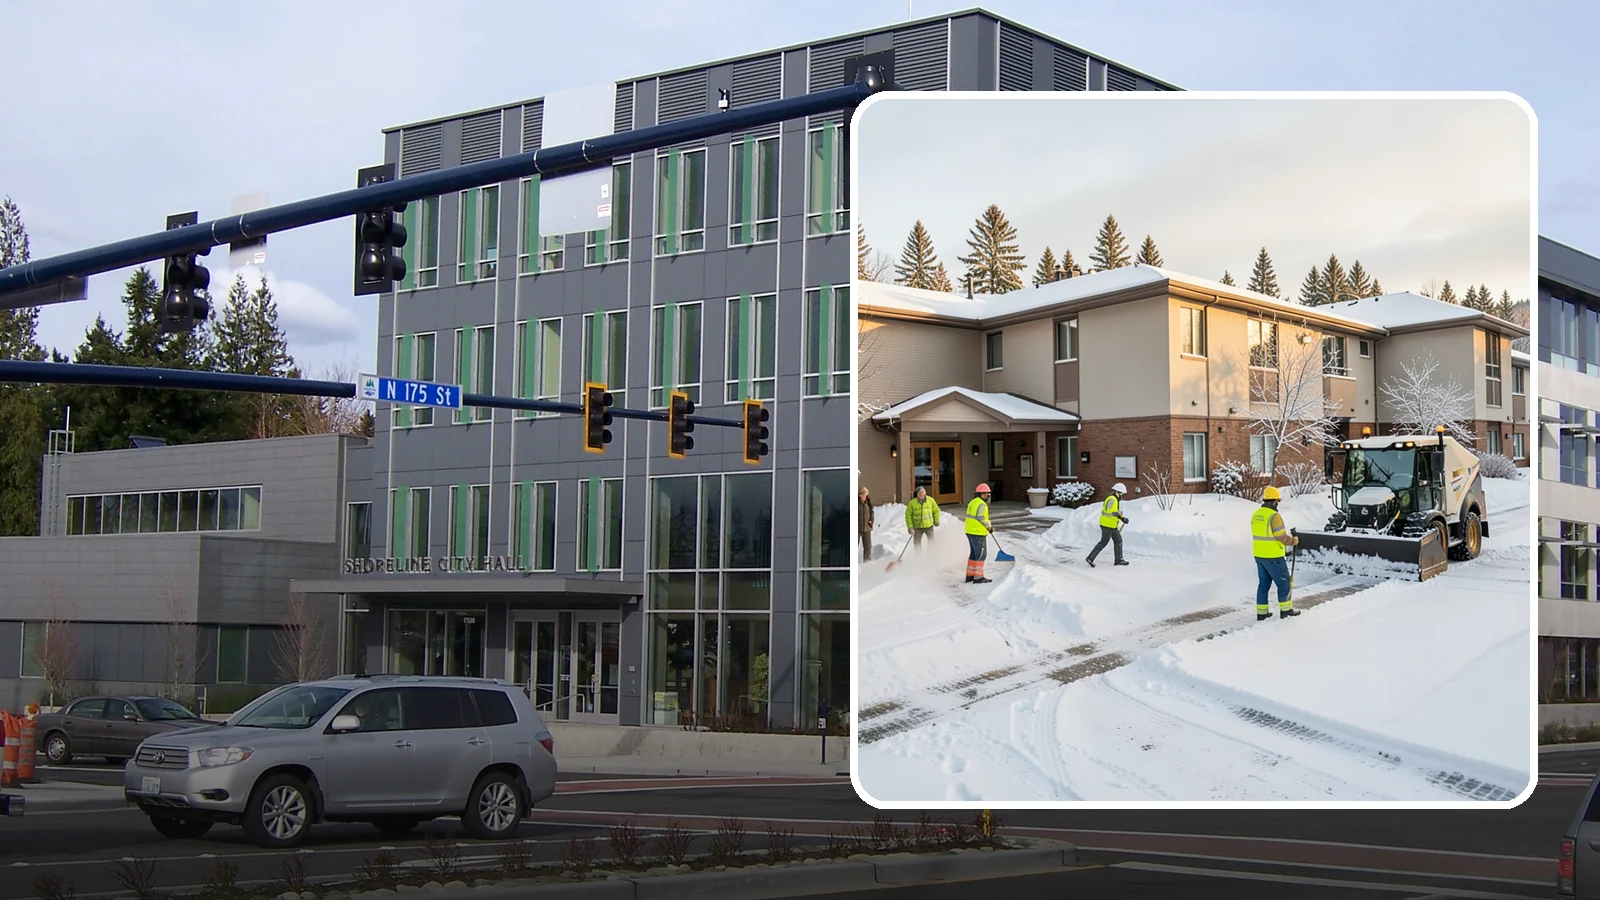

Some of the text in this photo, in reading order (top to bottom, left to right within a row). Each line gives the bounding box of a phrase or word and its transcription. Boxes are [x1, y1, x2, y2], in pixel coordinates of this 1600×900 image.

[387, 380, 451, 406] N 175 St
[344, 555, 525, 574] SHORELINE CITY HALL
